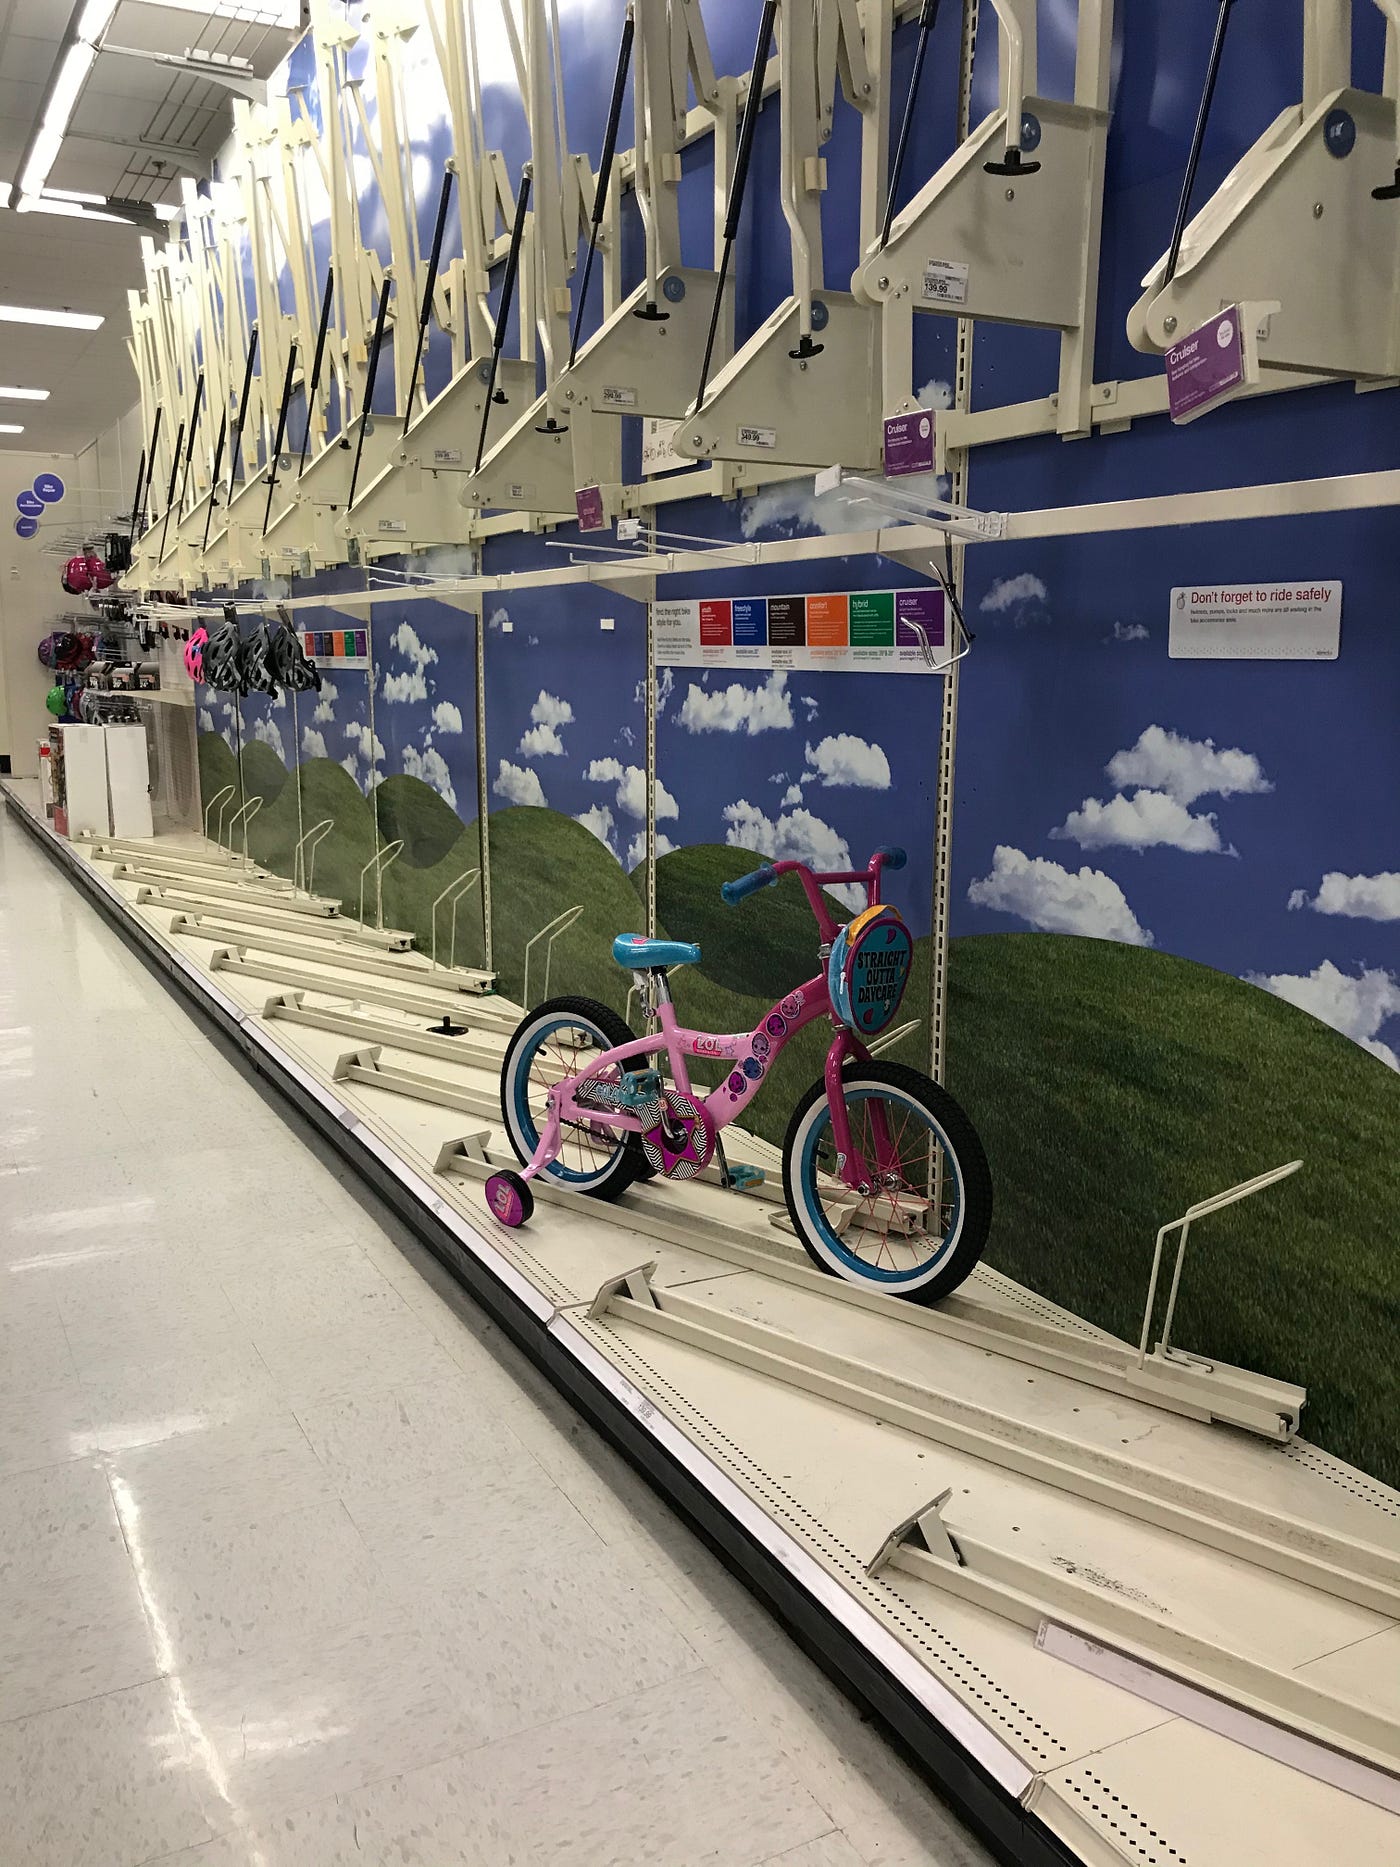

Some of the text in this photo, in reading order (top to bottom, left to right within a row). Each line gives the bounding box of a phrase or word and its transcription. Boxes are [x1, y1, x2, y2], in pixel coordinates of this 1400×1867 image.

[925, 283, 948, 293] 139.99
[1169, 340, 1199, 365] Cruiser
[887, 423, 908, 435] Cruiser
[852, 599, 868, 609] hybrid
[1191, 587, 1332, 605] Don't forget to ride safely
[670, 608, 680, 617] right
[681, 607, 691, 615] bike
[858, 950, 907, 969] STRAIGHT
[866, 968, 896, 985] OUTTA
[858, 983, 899, 1003] DAYCARE
[695, 1035, 722, 1052] LOL
